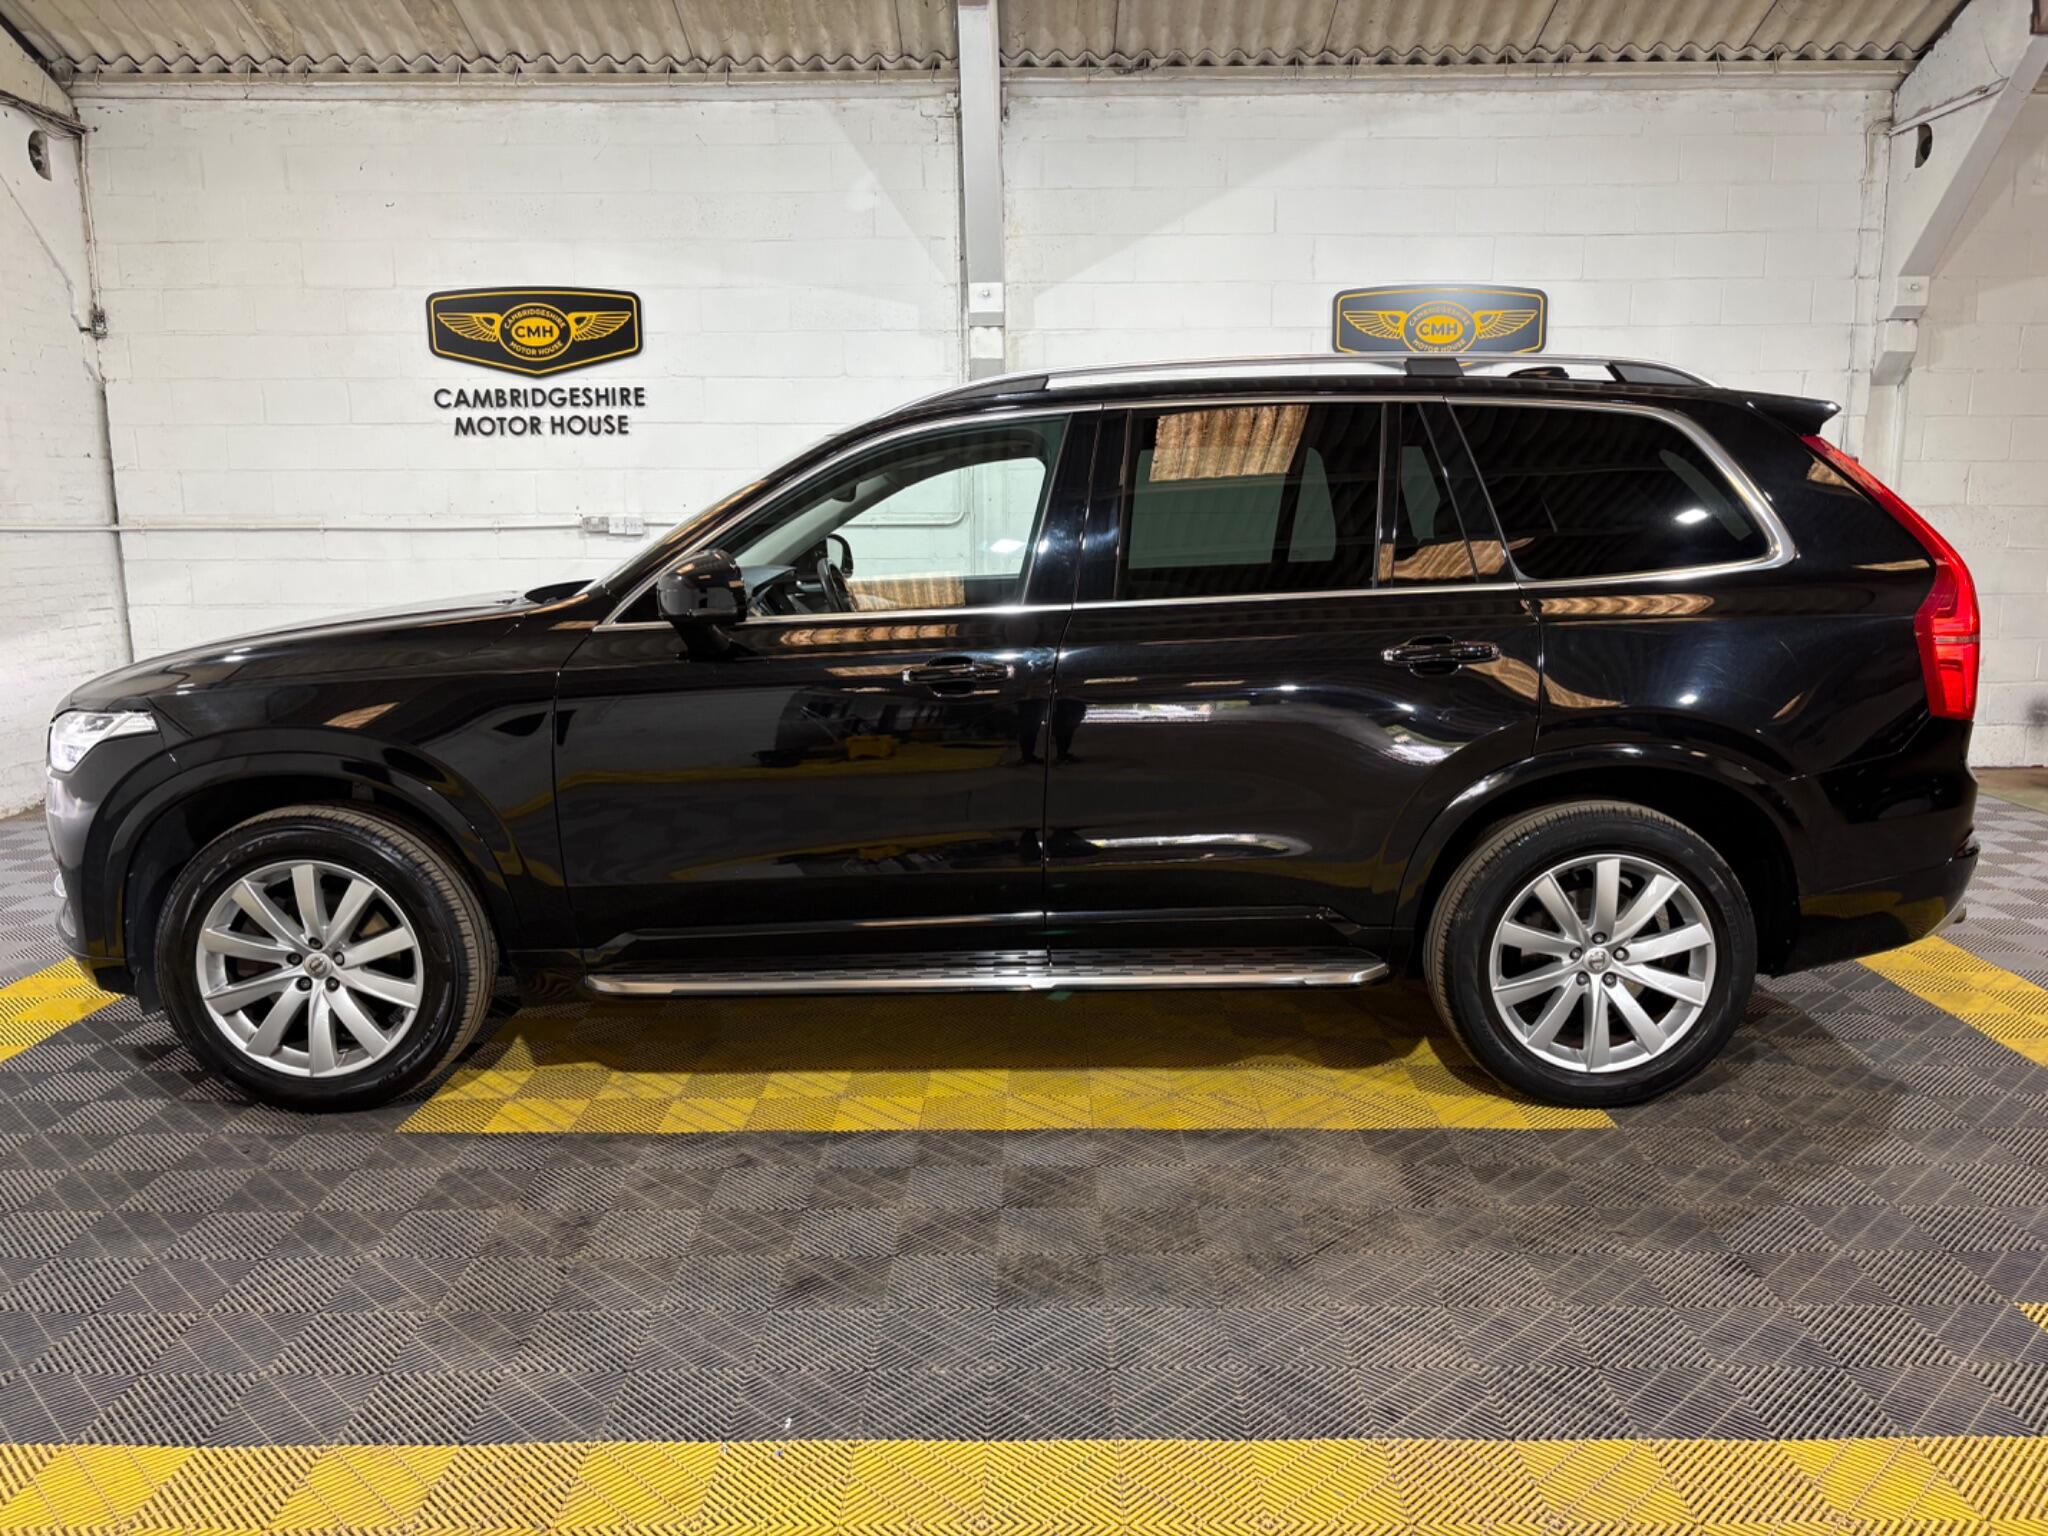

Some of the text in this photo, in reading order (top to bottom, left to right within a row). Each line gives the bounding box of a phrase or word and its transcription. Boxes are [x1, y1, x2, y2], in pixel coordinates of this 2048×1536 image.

[504, 308, 566, 329] CAMBRIDGESHIRE
[514, 325, 553, 338] CMH
[1418, 323, 1458, 337] CMH
[509, 341, 563, 355] MOTOR HOUSE
[433, 387, 646, 409] CAMBRIDGESHIRE
[454, 414, 630, 437] MOTOR HOUSE
